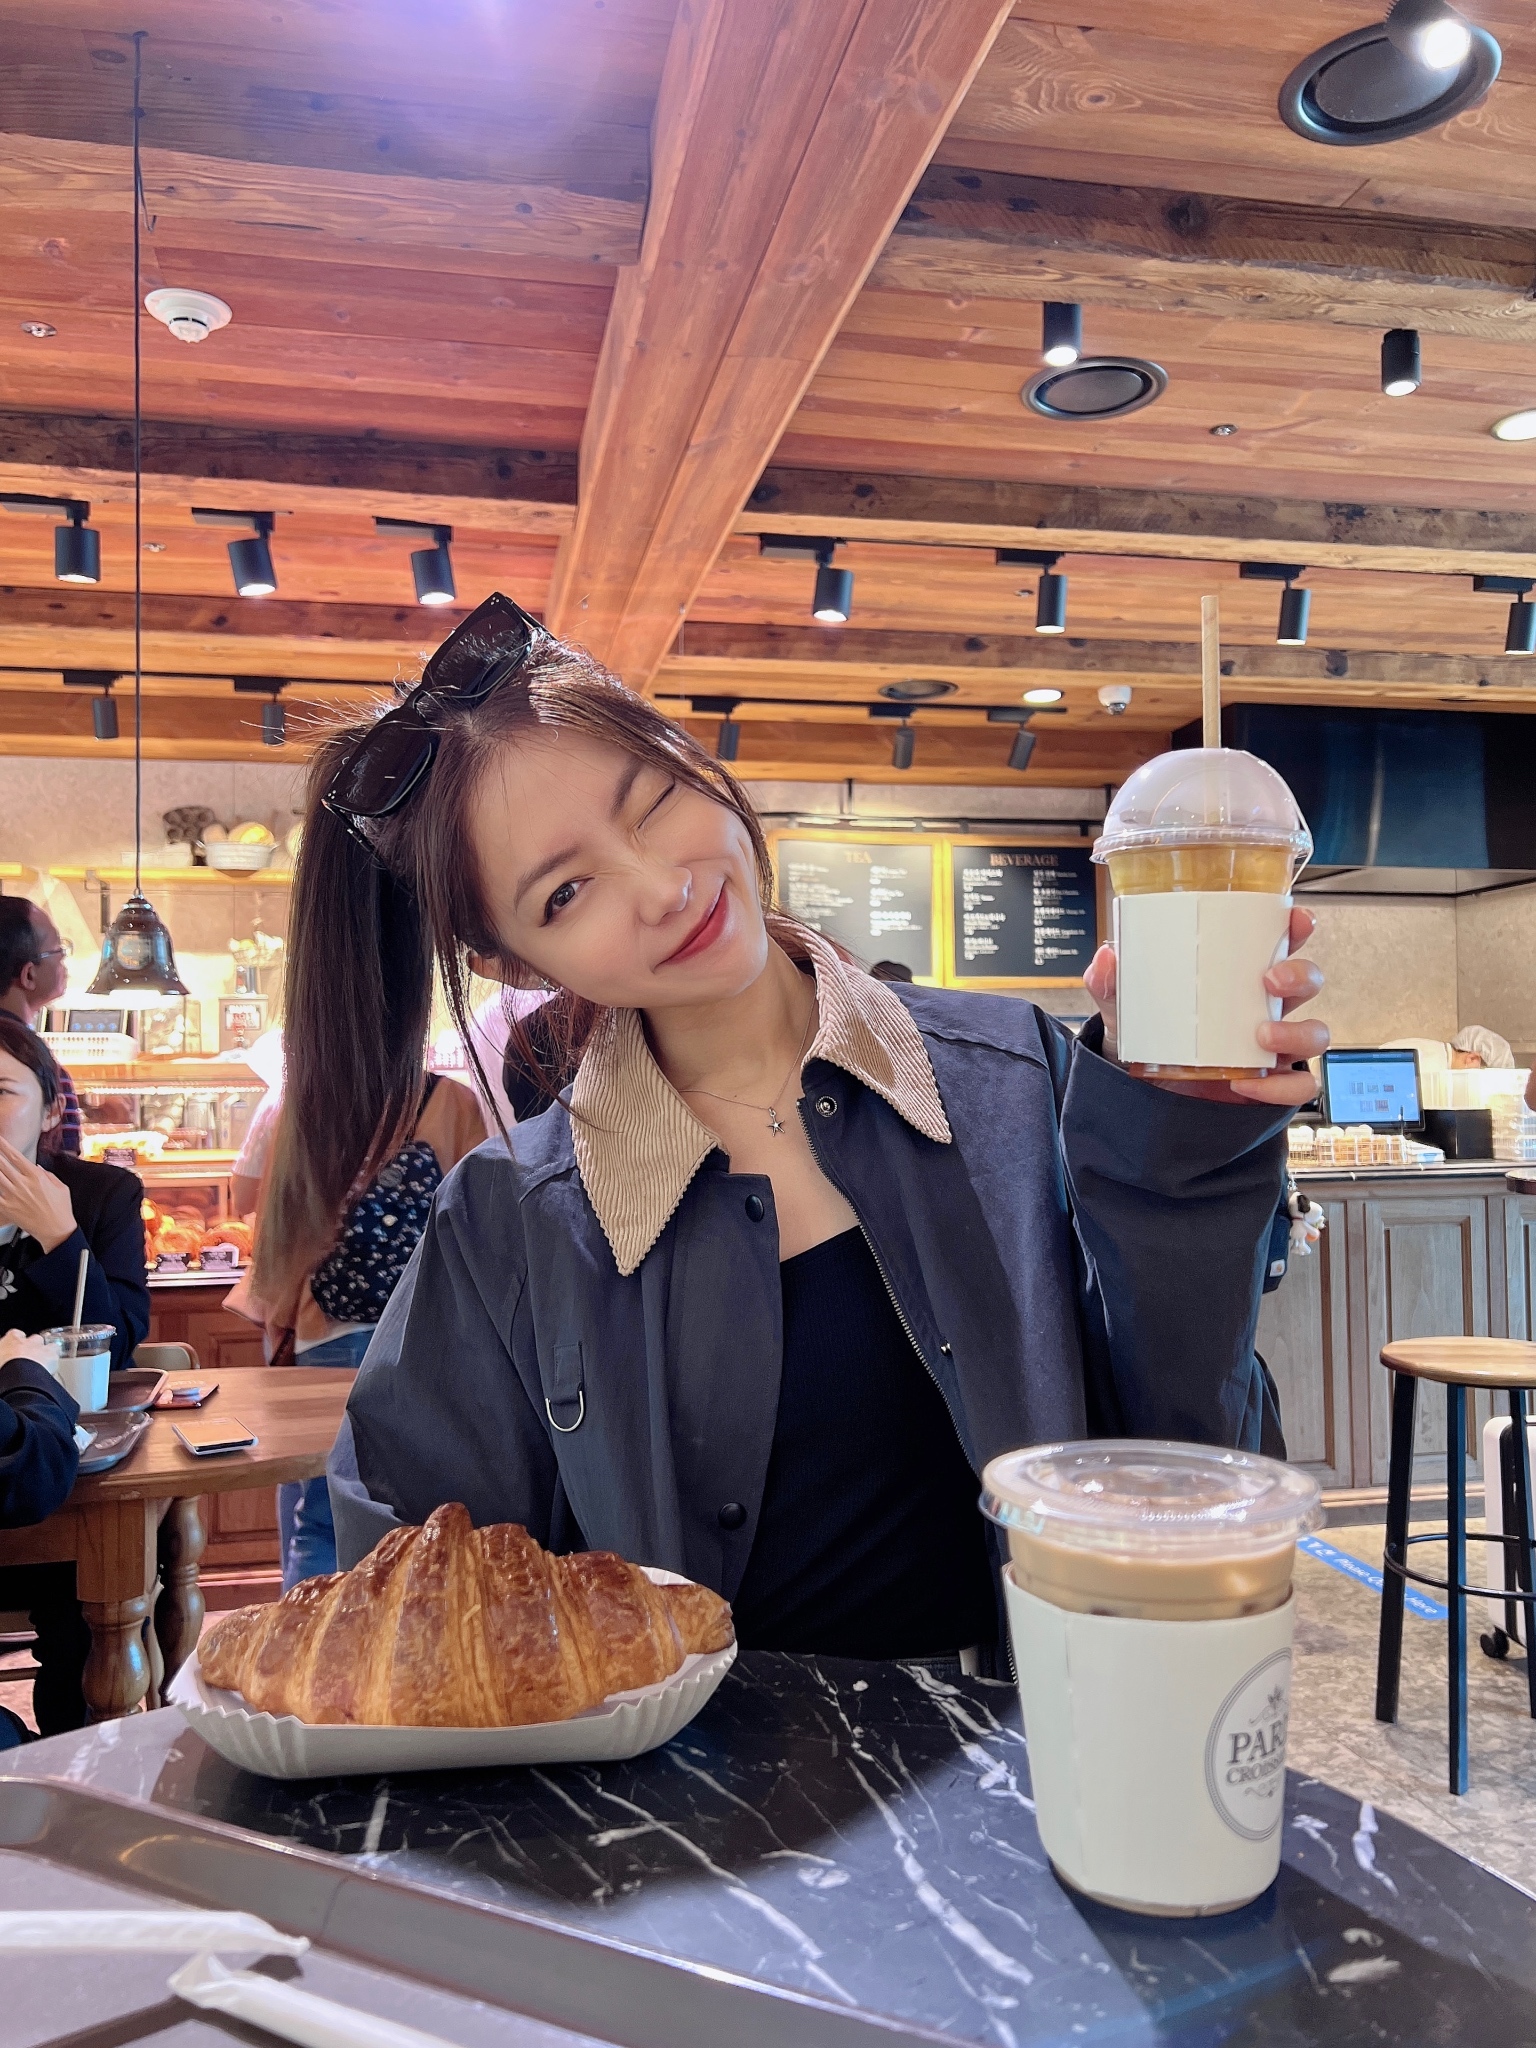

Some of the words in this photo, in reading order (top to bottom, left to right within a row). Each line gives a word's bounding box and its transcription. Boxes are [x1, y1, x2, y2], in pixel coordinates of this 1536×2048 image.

[844, 851, 873, 863] TEA
[990, 853, 1059, 866] BEVERAGE
[1226, 1716, 1287, 1764] PAR
